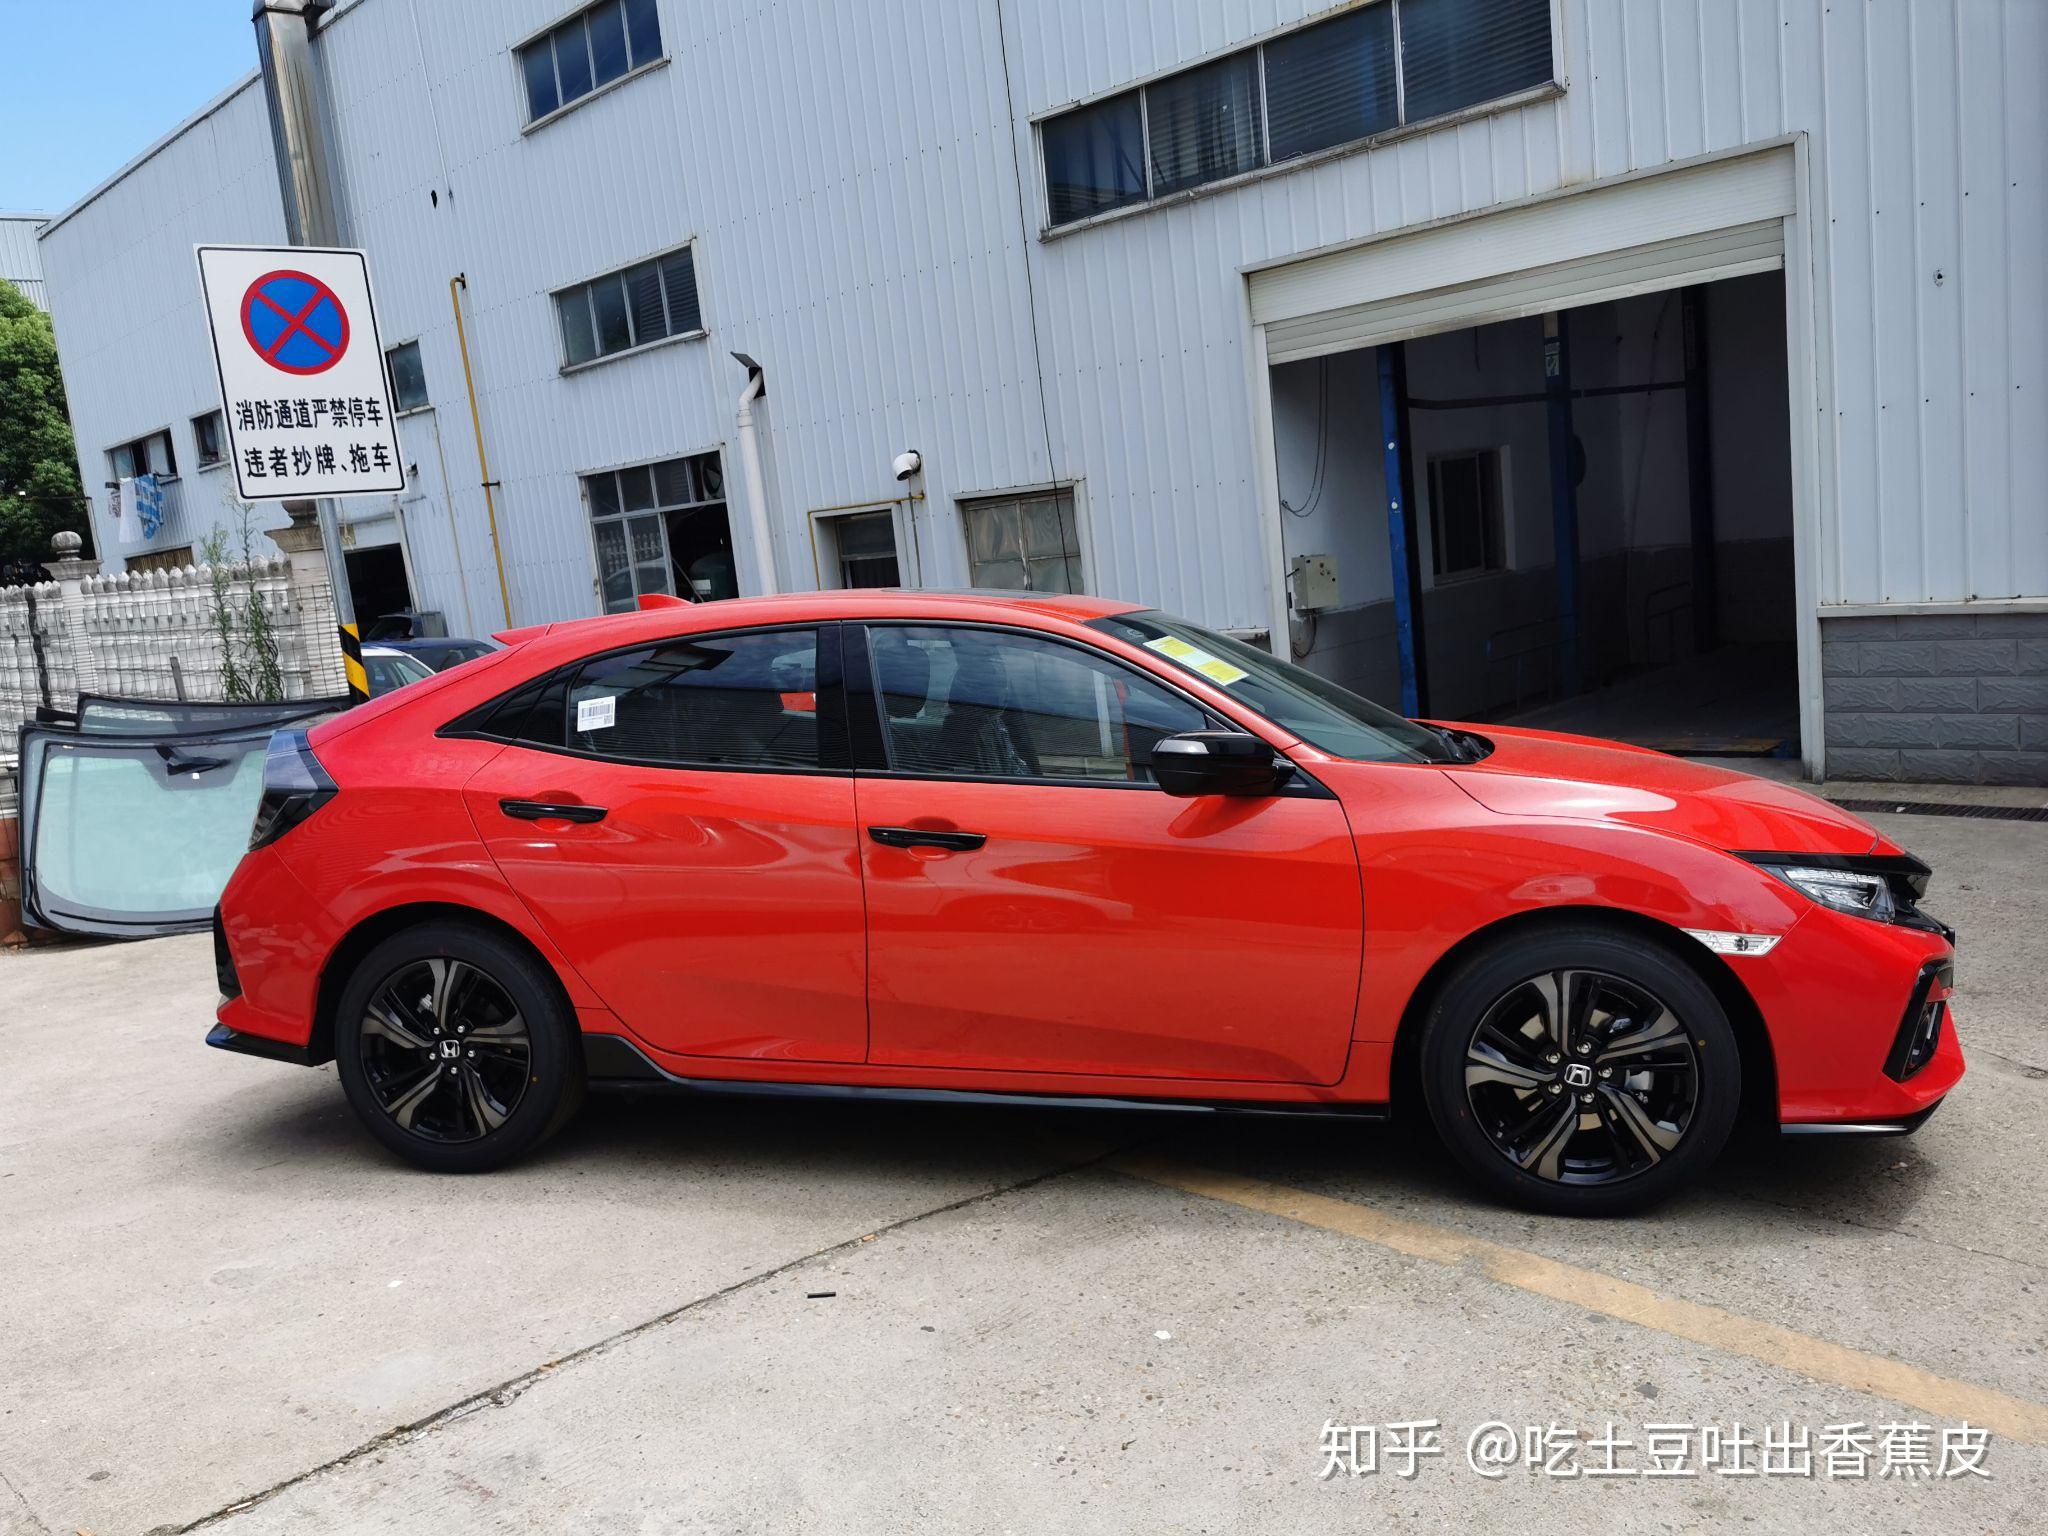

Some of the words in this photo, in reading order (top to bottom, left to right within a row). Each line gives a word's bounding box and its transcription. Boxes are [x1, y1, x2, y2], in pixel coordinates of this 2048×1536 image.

[236, 397, 384, 431] 消防通道严禁停车
[244, 442, 392, 478] 违者抄牌、拖车
